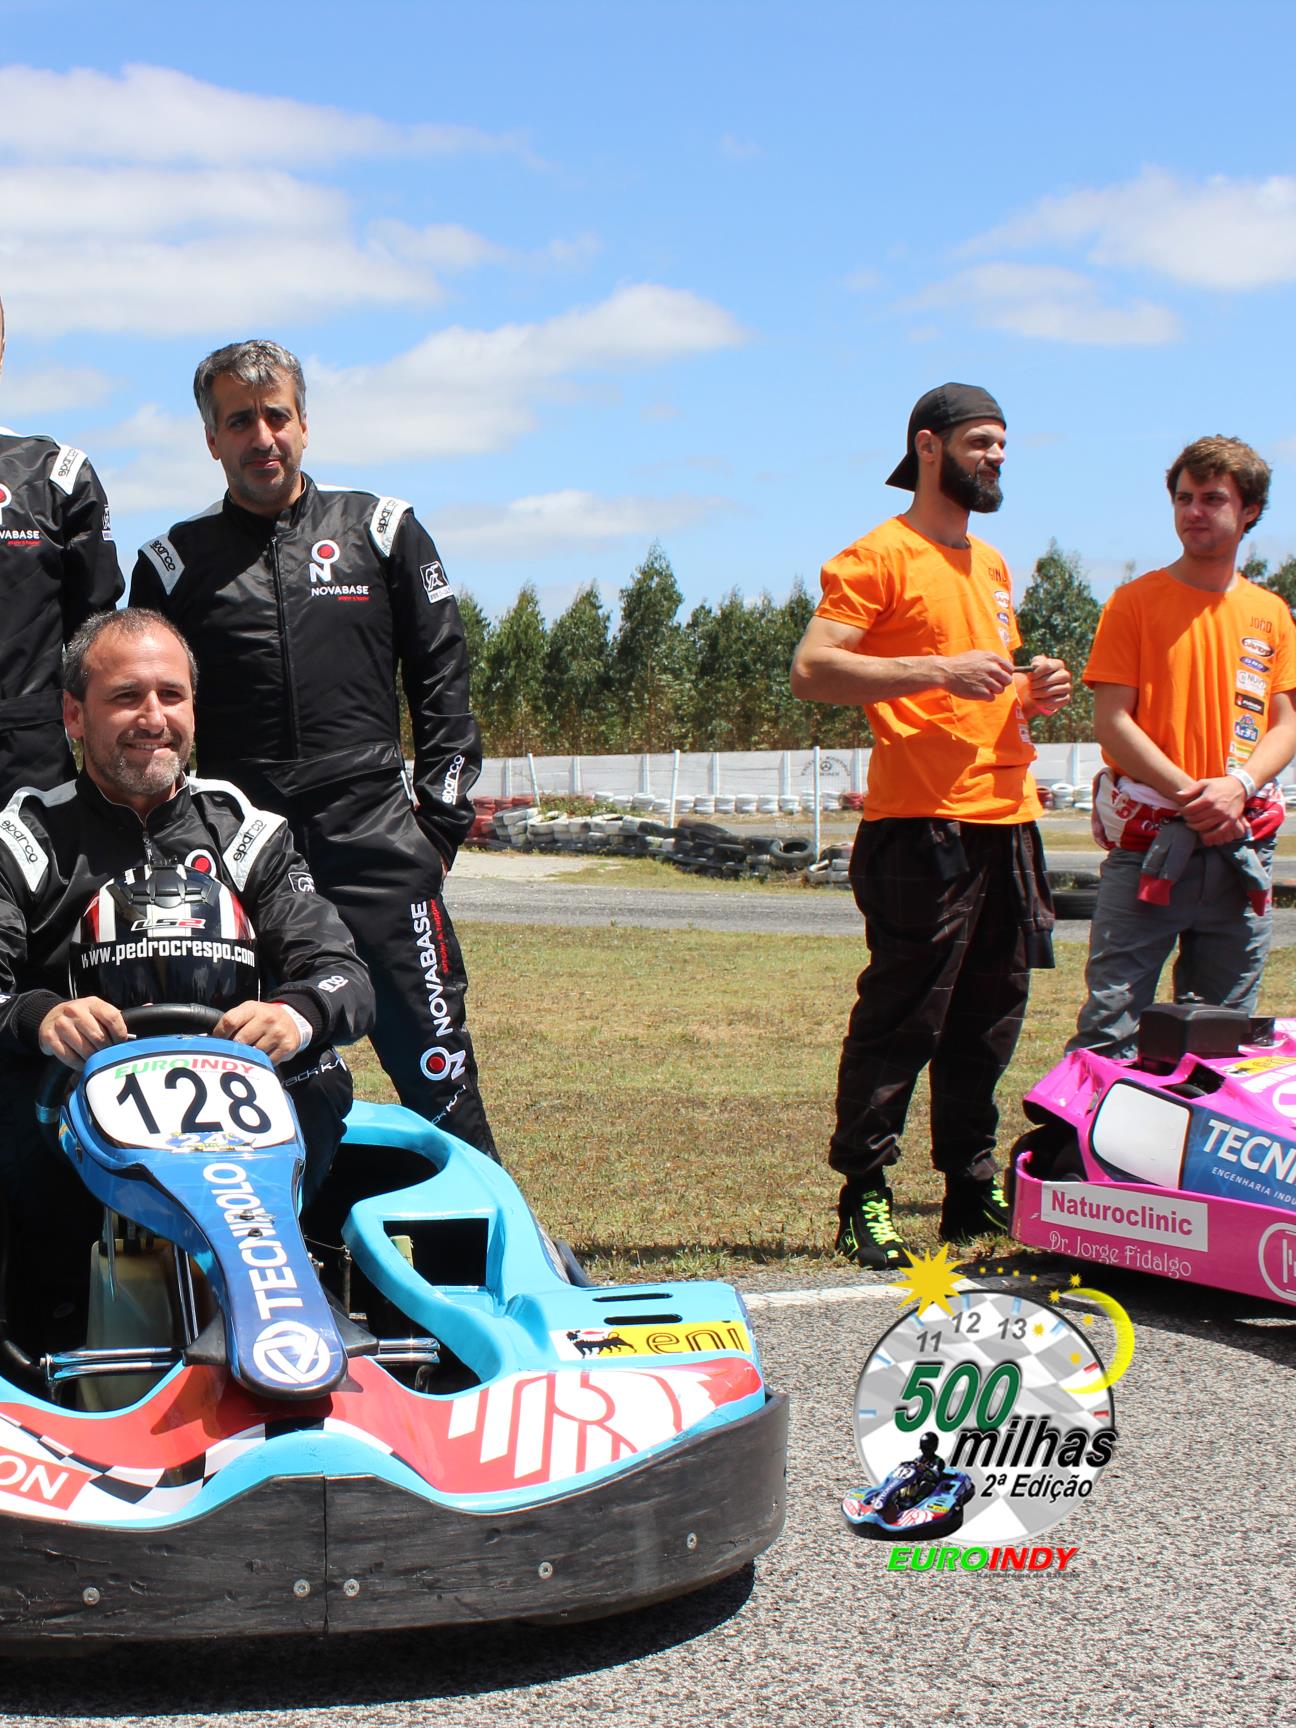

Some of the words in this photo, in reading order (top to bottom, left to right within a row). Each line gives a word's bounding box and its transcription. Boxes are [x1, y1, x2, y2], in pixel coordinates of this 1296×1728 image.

[311, 585, 369, 596] NOVABASE
[442, 754, 465, 805] sparco
[233, 820, 267, 863] sparco
[411, 901, 453, 1036] NOVABASE
[116, 1067, 272, 1134] 128
[1211, 1166, 1271, 1196] ENGENHARIA
[1051, 1190, 1193, 1236] Naturoclinic
[204, 1162, 304, 1321] TECNIROLO
[1049, 1230, 1071, 1255] Dr.
[1076, 1236, 1119, 1265] Jorge
[1124, 1244, 1192, 1279] Fidalgo
[646, 1320, 744, 1355] eni
